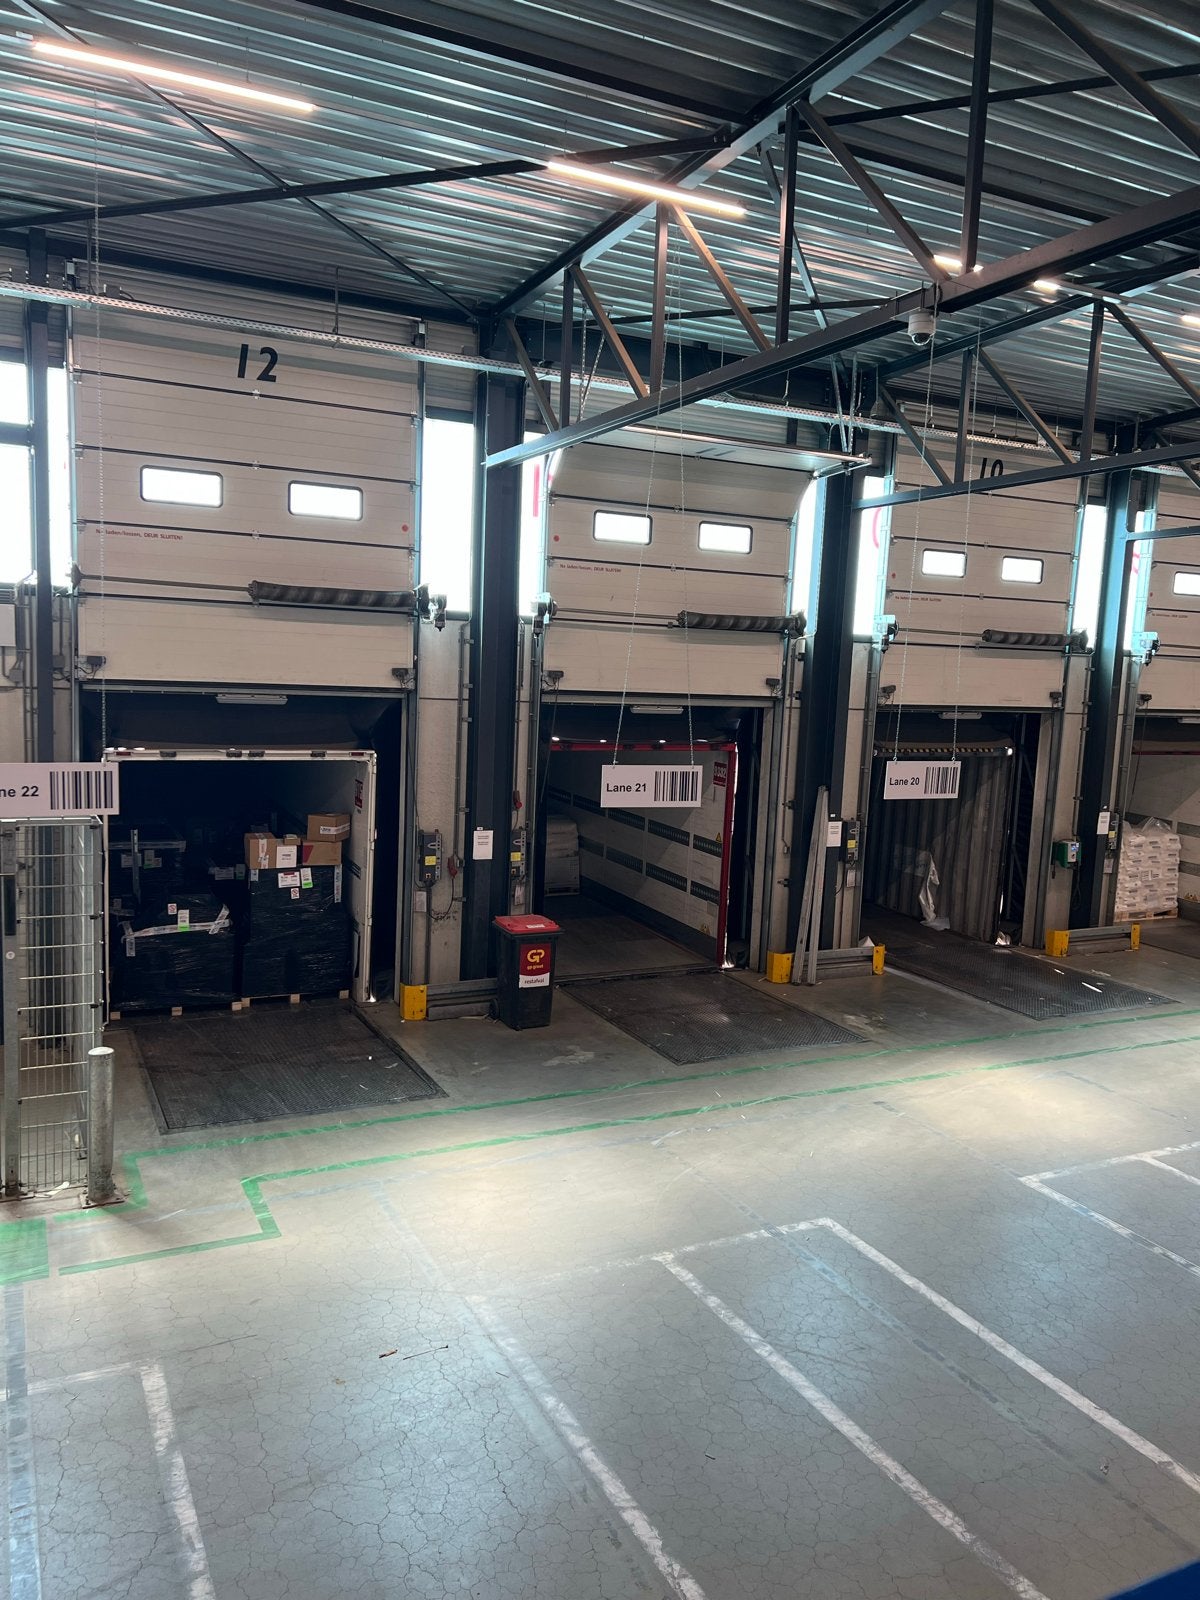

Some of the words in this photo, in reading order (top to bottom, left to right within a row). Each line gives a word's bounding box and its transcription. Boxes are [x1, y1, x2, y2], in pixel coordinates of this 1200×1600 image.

[237, 343, 279, 383] 12
[889, 777, 909, 786] Lane
[910, 776, 920, 786] 20
[0, 788, 16, 798] ne
[21, 785, 40, 798] 22
[606, 783, 632, 793] Lane
[635, 783, 647, 792] 21
